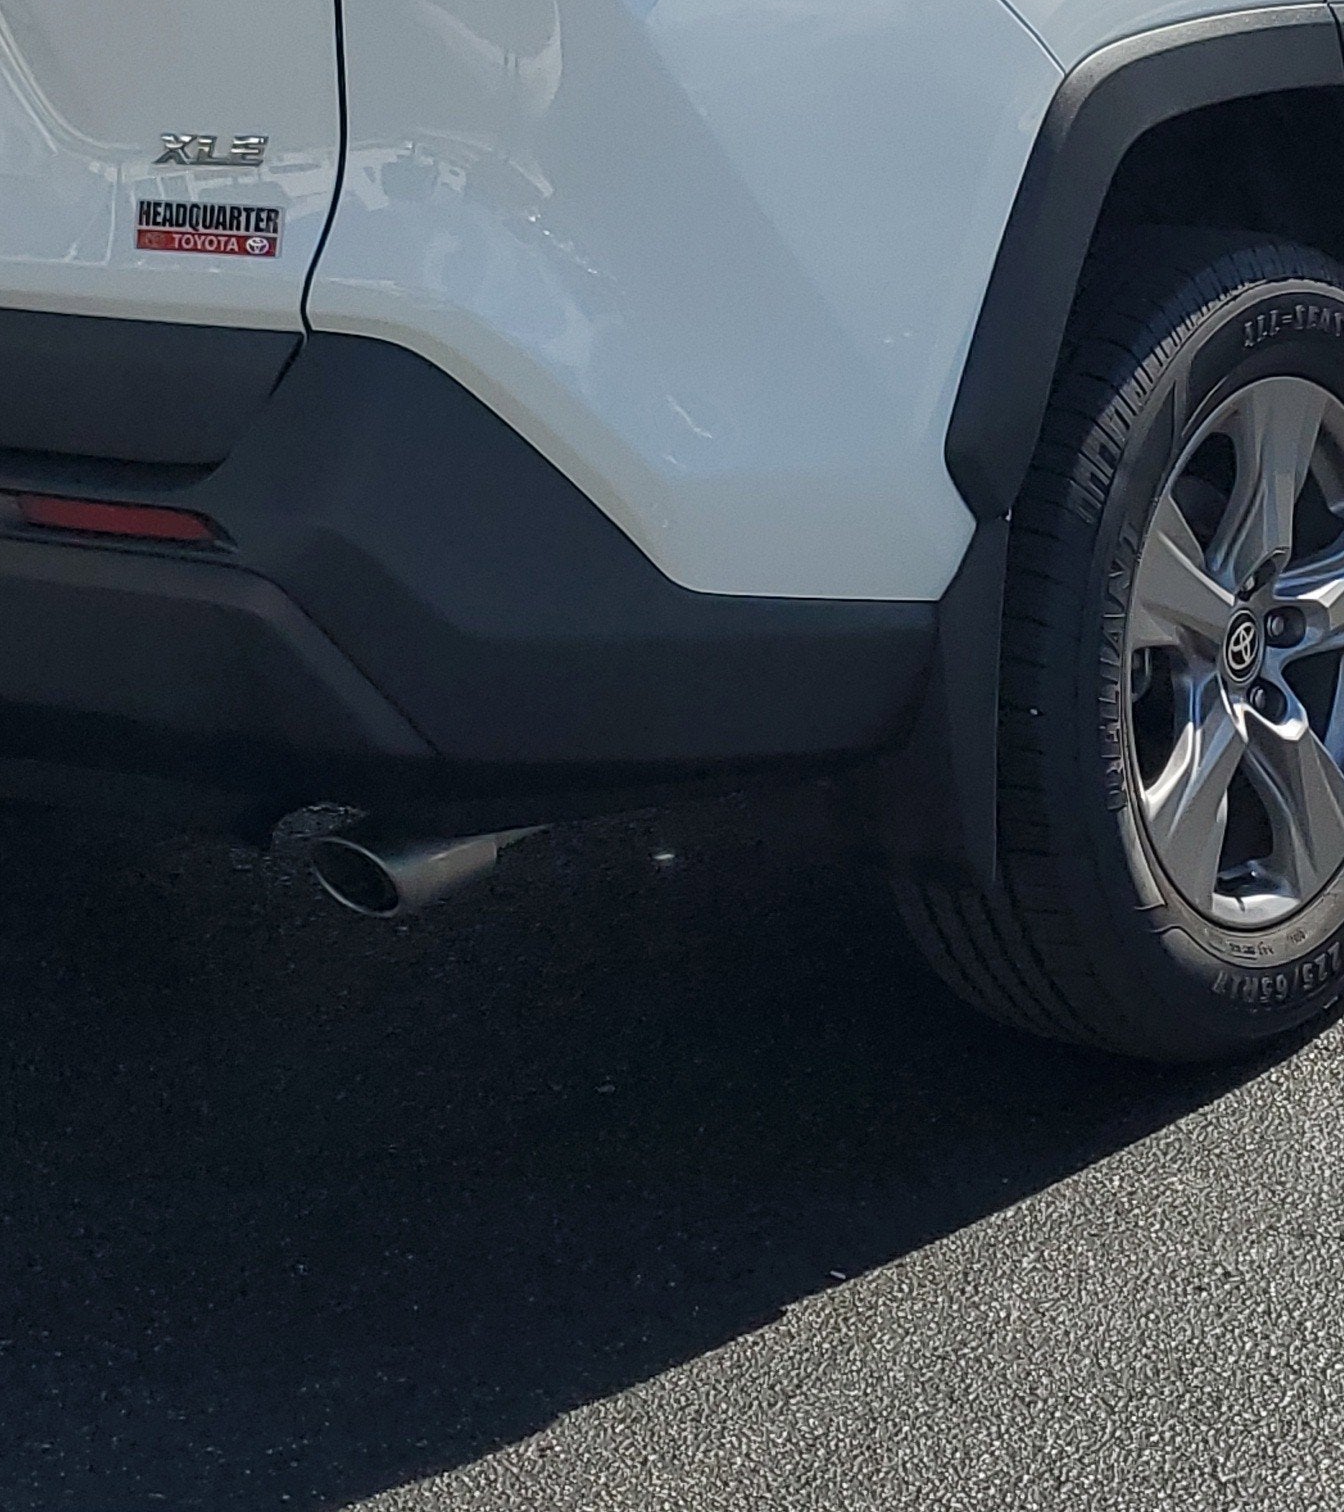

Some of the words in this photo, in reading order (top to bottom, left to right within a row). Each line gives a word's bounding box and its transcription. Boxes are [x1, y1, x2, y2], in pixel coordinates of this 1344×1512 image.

[152, 132, 270, 168] XLE
[138, 200, 280, 234] HEADQUARTER
[172, 233, 240, 253] TOYOTA
